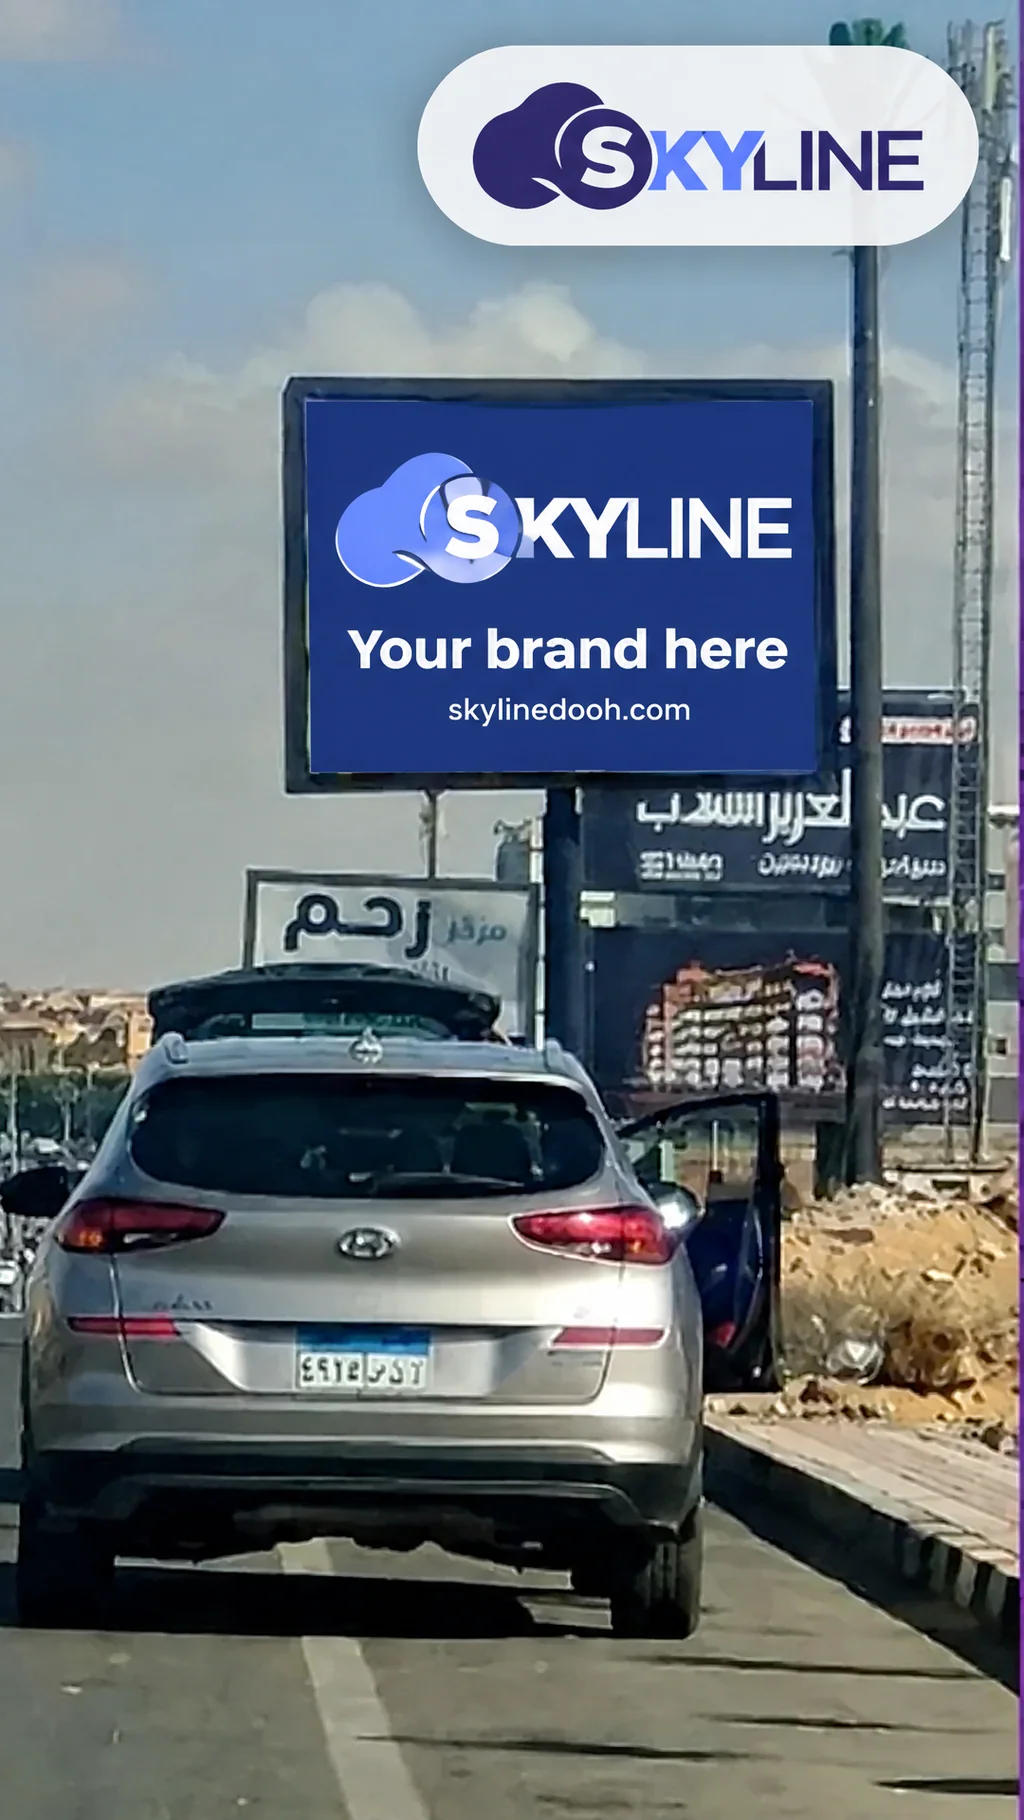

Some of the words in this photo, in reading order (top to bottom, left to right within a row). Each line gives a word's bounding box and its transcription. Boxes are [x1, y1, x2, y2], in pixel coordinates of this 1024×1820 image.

[444, 494, 793, 560] SKYLINE
[347, 629, 472, 670] Your
[487, 627, 648, 670] brand
[665, 627, 788, 670] here
[448, 698, 691, 728] skylinedooh.com
